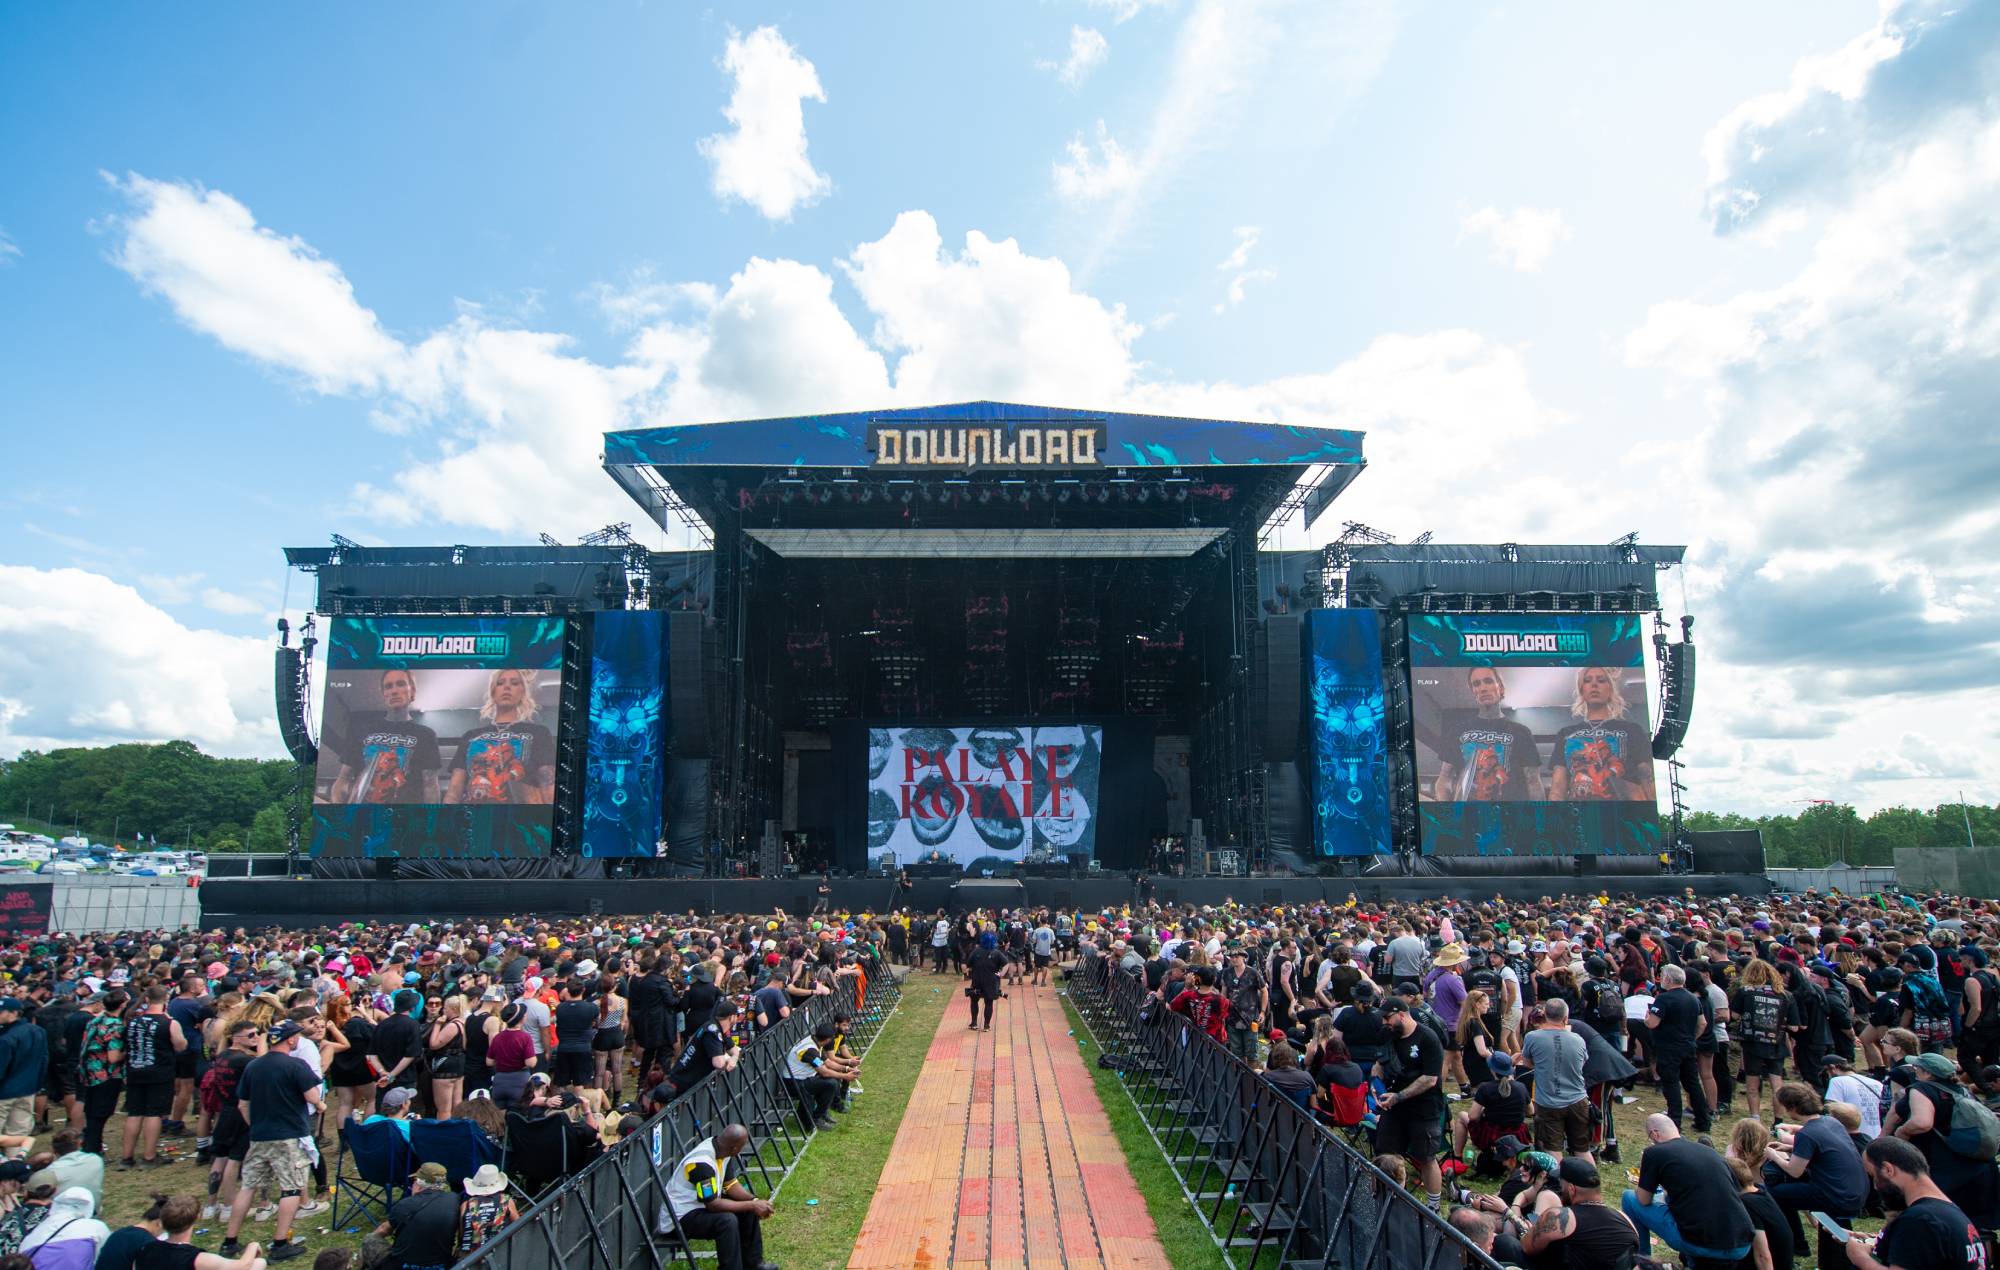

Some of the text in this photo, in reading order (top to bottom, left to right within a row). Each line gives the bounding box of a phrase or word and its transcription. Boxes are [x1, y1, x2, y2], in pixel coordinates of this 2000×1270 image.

[876, 428, 1098, 467] DOWNLOAD
[382, 637, 504, 655] DOWNLOAD XXII
[1464, 634, 1585, 652] DOWNLOAD XXII
[902, 745, 1073, 782] PALAYE
[899, 783, 1074, 820] ROYALE
